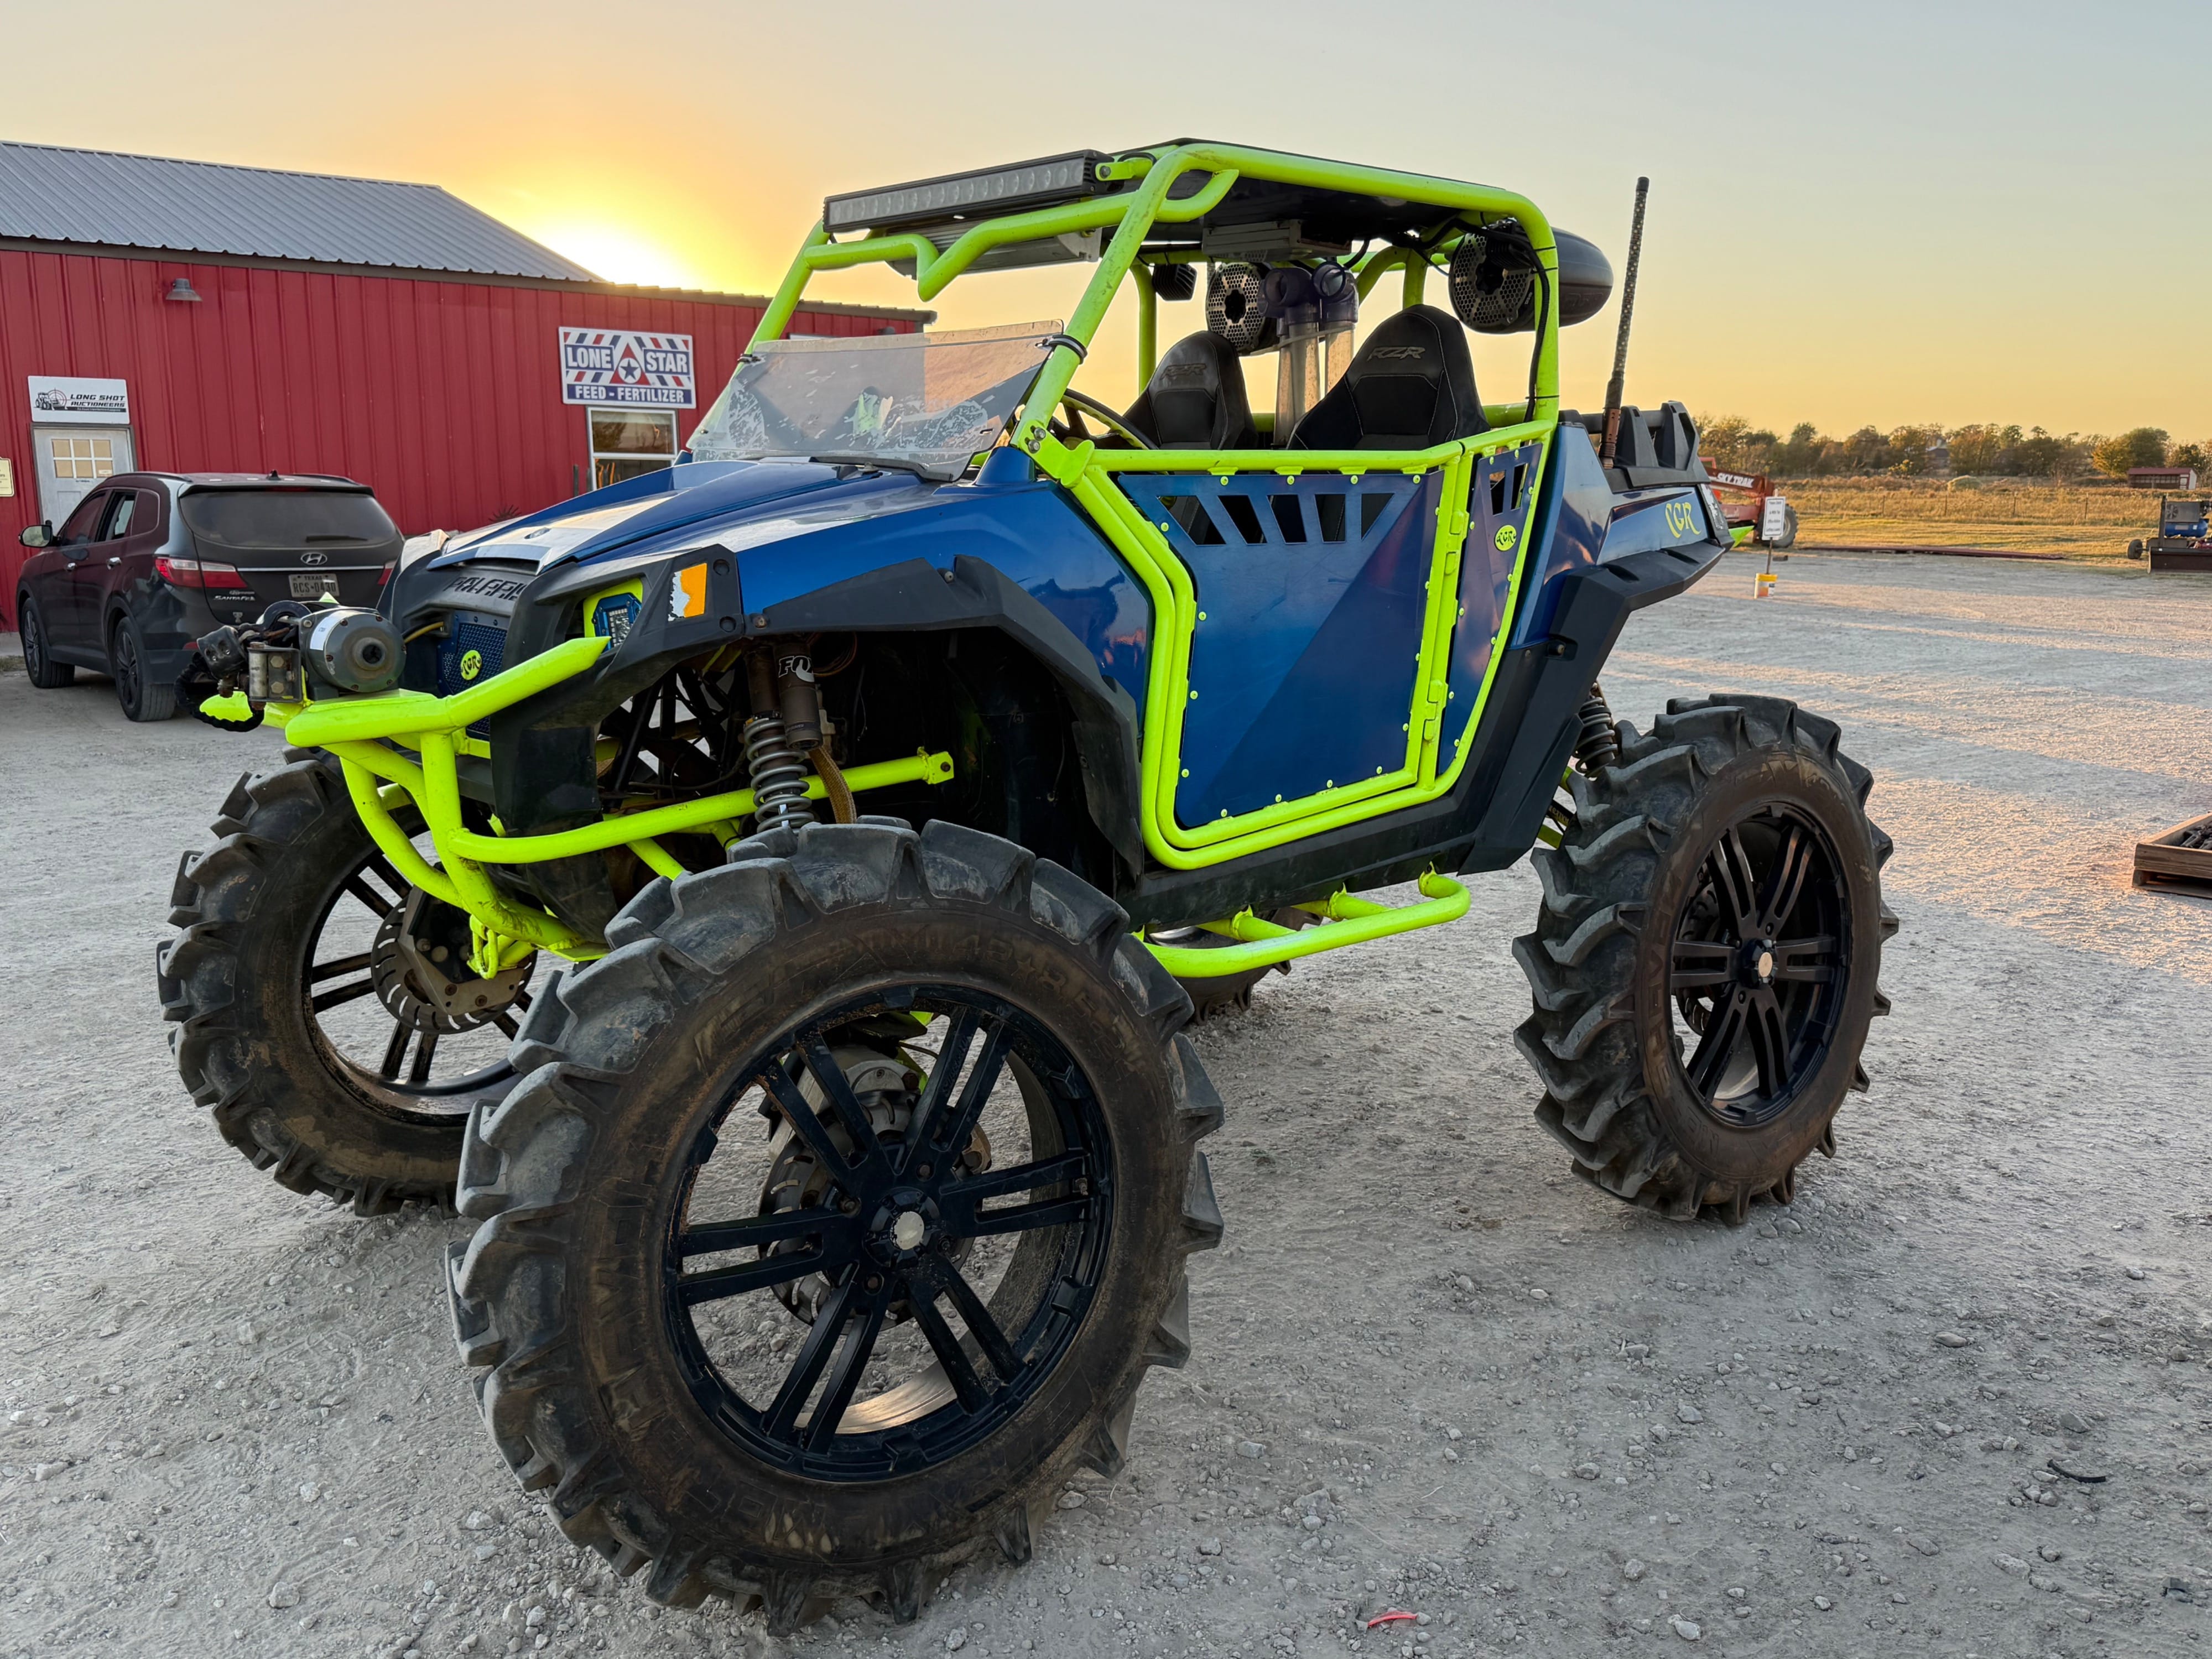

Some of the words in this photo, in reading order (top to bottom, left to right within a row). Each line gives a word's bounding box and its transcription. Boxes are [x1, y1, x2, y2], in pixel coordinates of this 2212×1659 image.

[566, 347, 612, 369] LONE
[646, 352, 688, 373] STAR
[1367, 346, 1425, 361] RZR
[575, 385, 606, 399] FEED
[617, 387, 684, 403] FERTILIZER
[1717, 472, 1733, 483] SKY
[1732, 476, 1755, 488] TRAK
